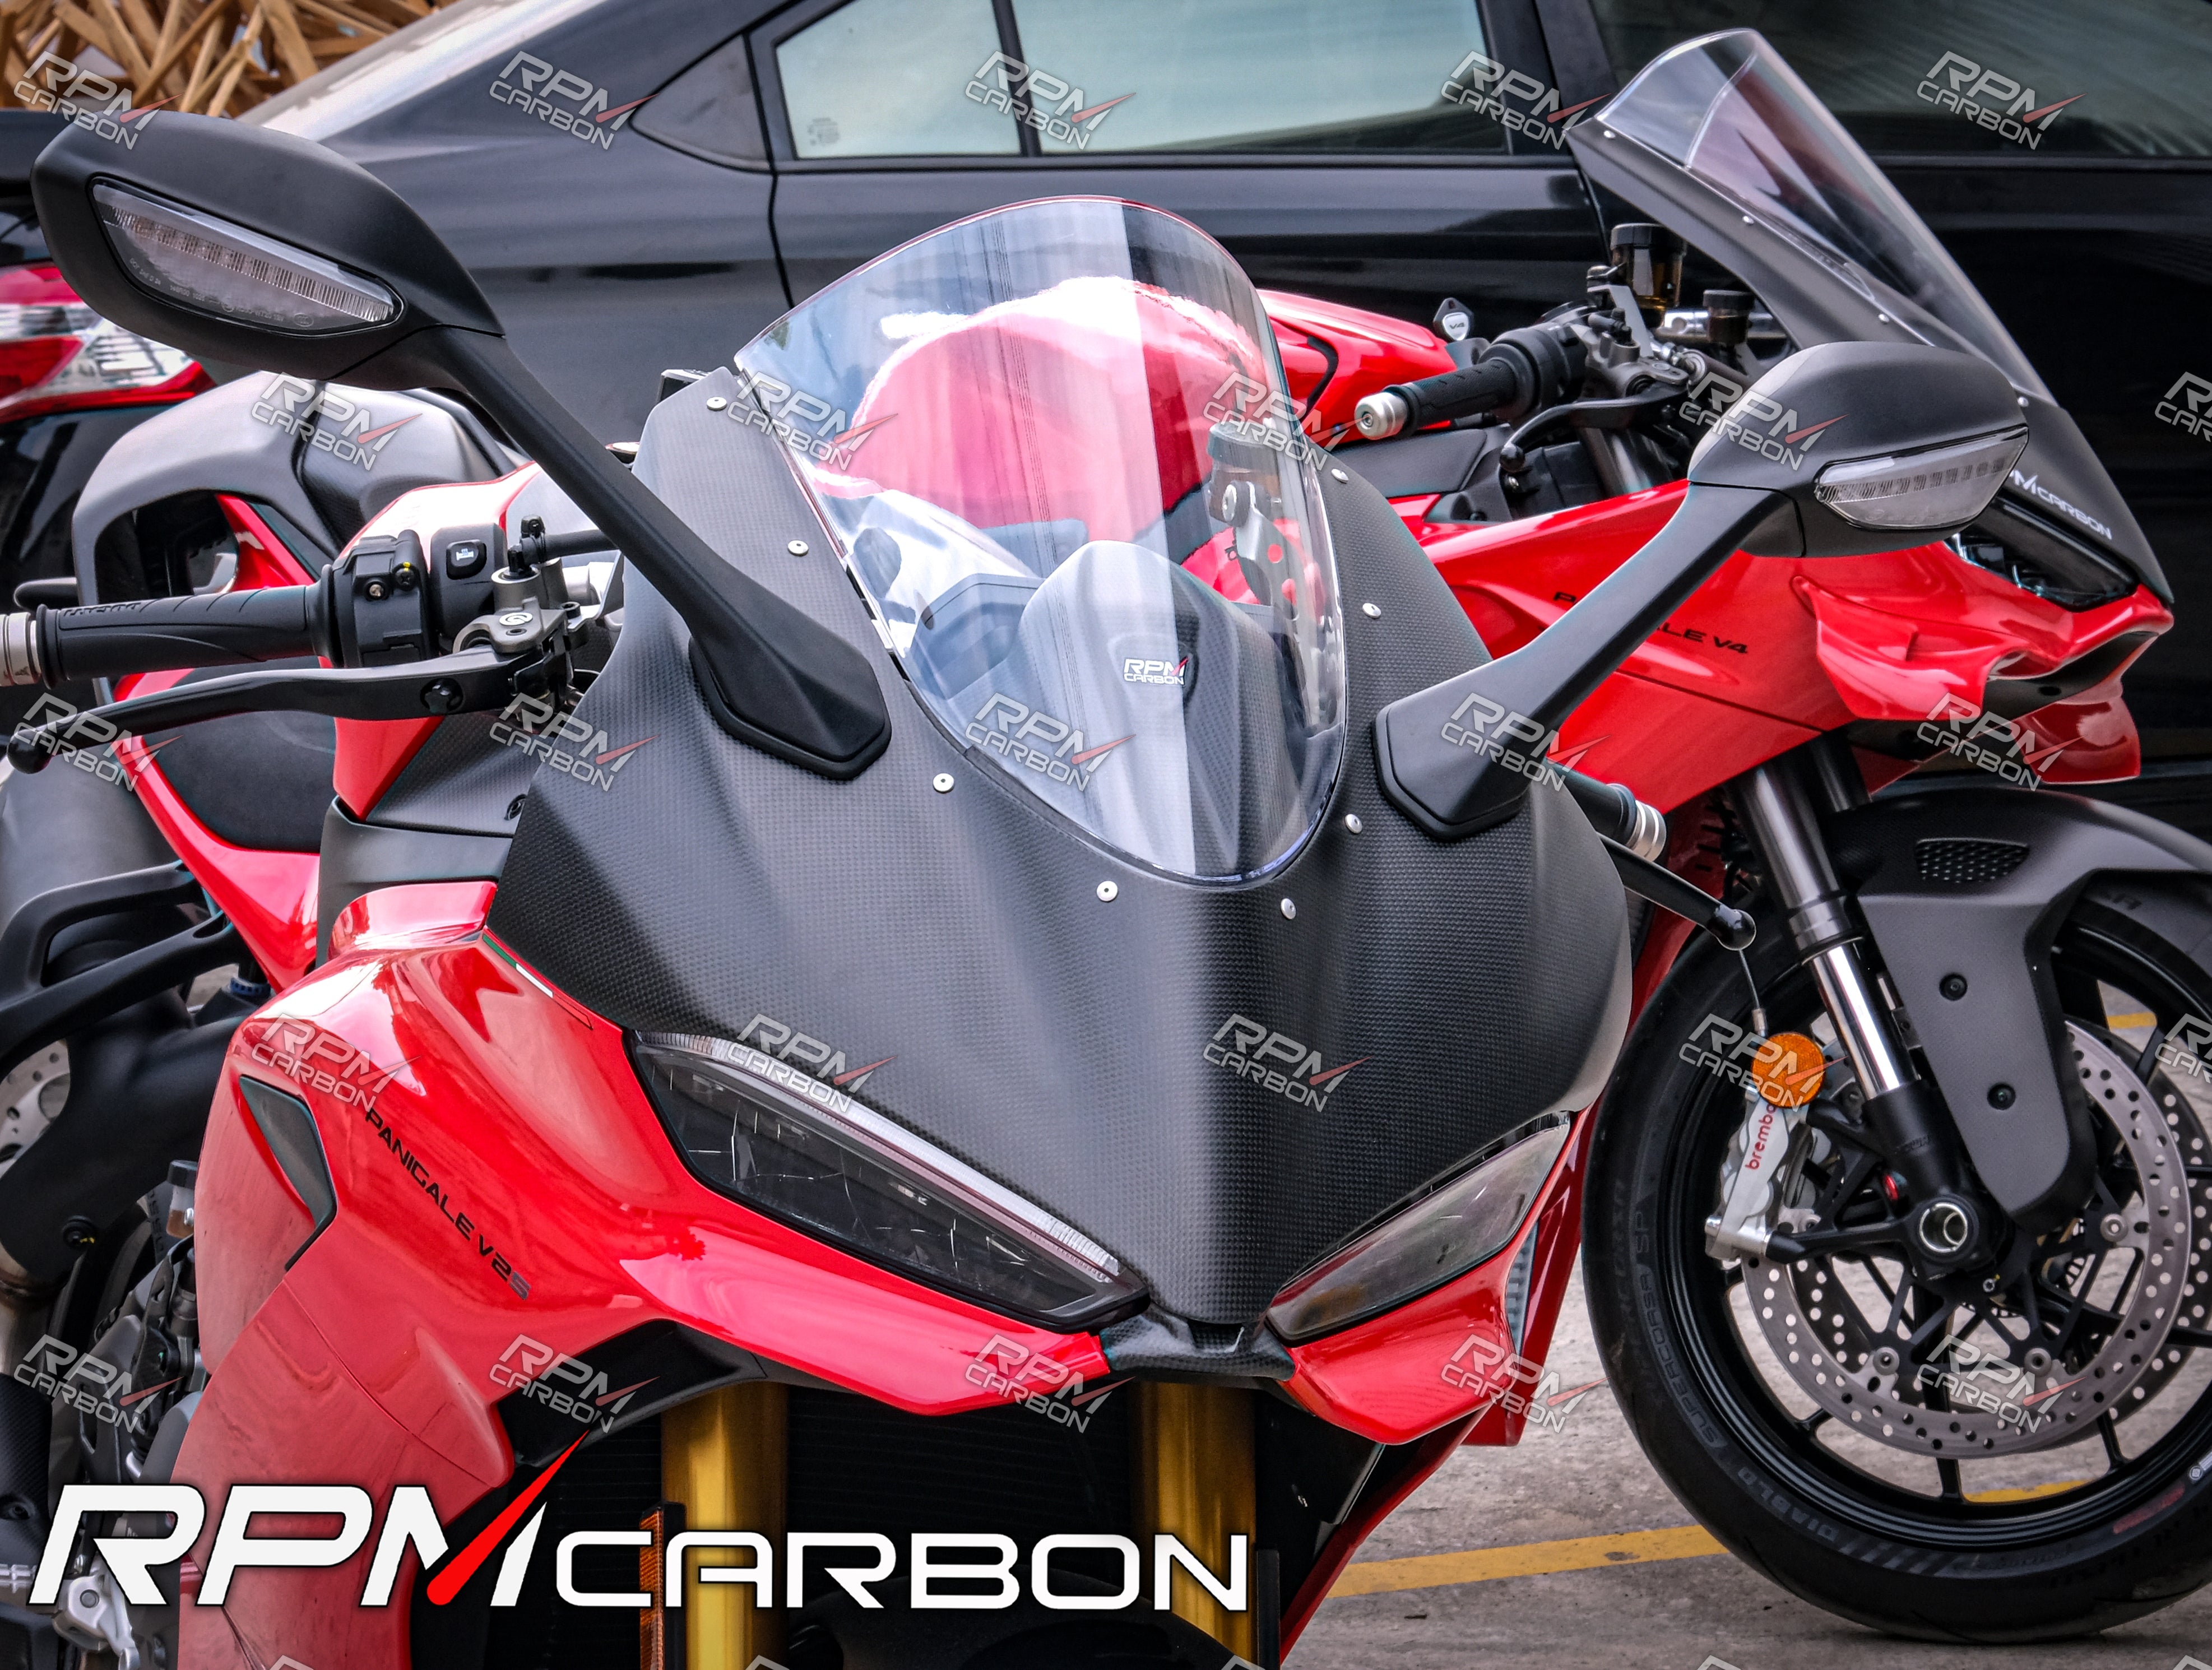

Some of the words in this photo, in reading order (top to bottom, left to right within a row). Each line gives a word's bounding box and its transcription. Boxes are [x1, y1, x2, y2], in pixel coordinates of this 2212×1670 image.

[1713, 635, 1749, 654] V4
[1124, 656, 1189, 677] RPM
[1124, 673, 1184, 685] CARBON
[1745, 1102, 1777, 1170] brembo
[365, 1107, 475, 1241] PANIGALE
